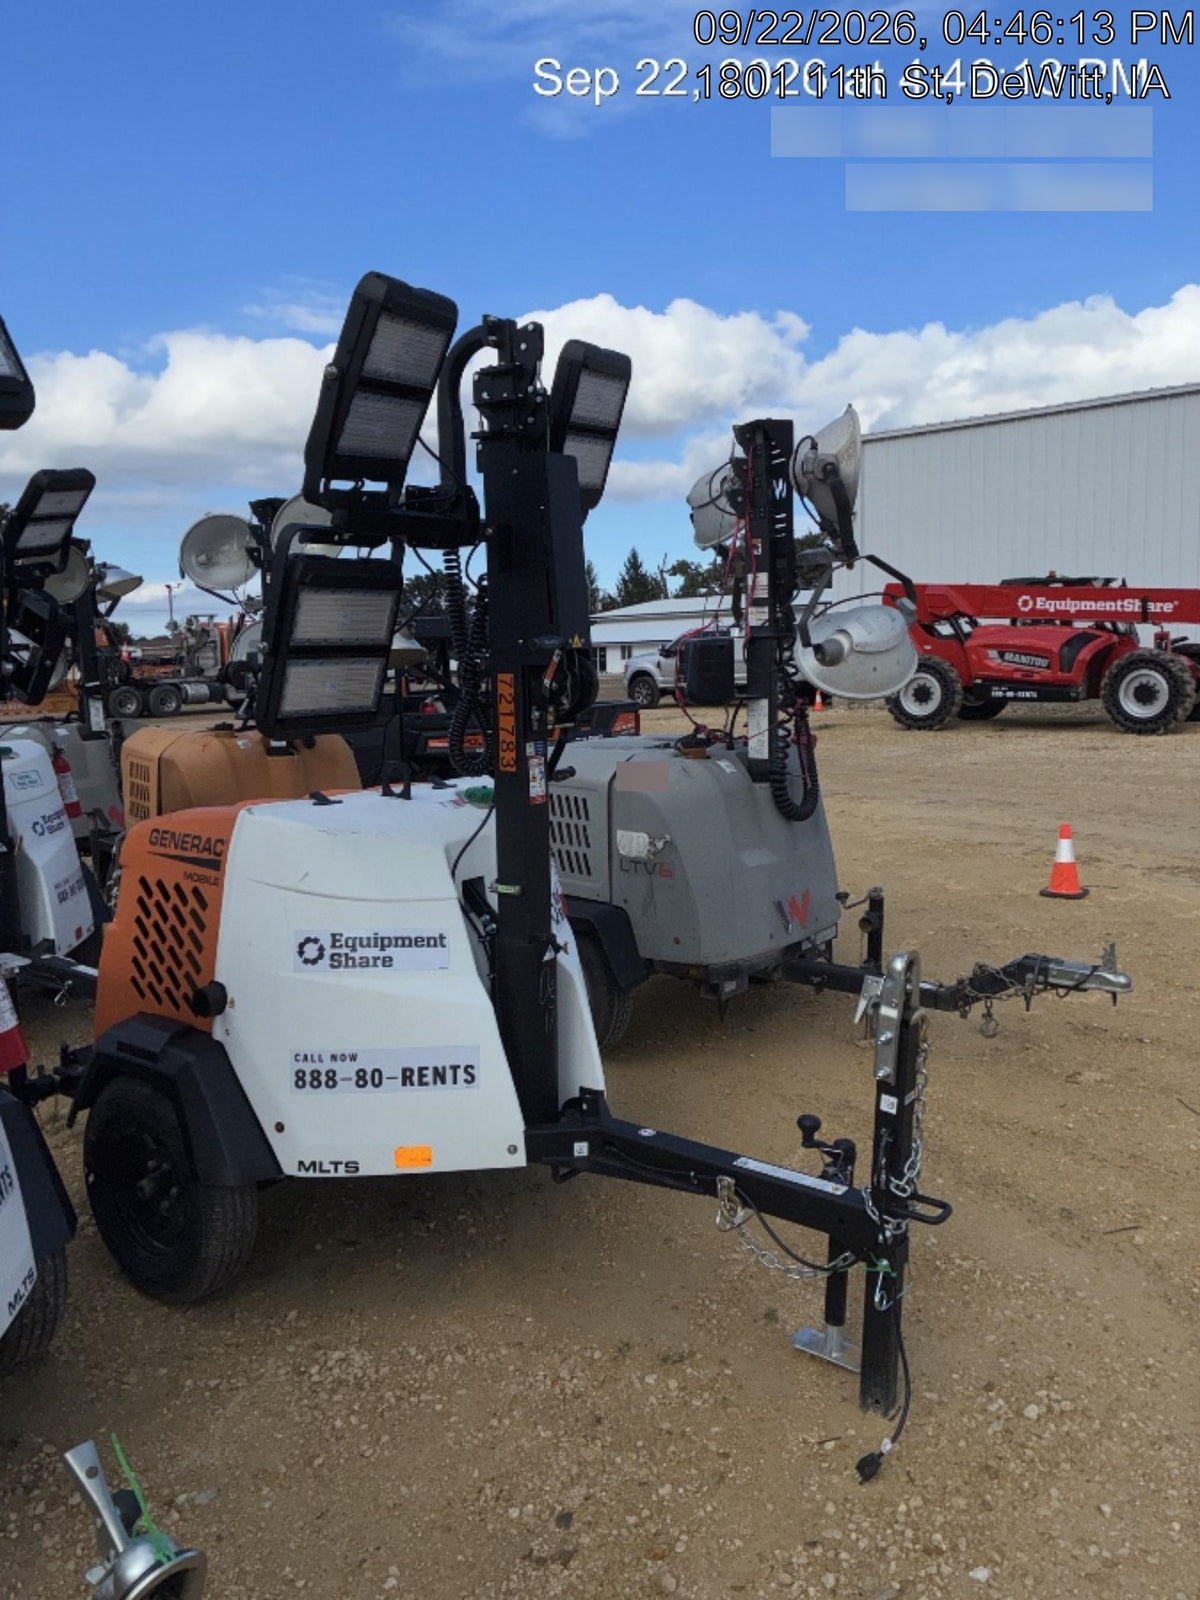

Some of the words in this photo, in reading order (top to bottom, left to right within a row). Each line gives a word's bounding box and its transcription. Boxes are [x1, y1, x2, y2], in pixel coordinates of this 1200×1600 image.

[1003, 651, 1050, 668] MANITOU
[499, 676, 516, 768] 721783
[149, 828, 225, 857] GENERAC
[183, 871, 219, 887] MOBILE
[330, 933, 447, 952] Equipment
[329, 952, 394, 969] Share
[294, 1053, 324, 1064] CALL
[330, 1052, 358, 1063] NOW
[294, 1064, 476, 1090] 888-80-RENTS
[297, 1160, 360, 1174] MLTS
